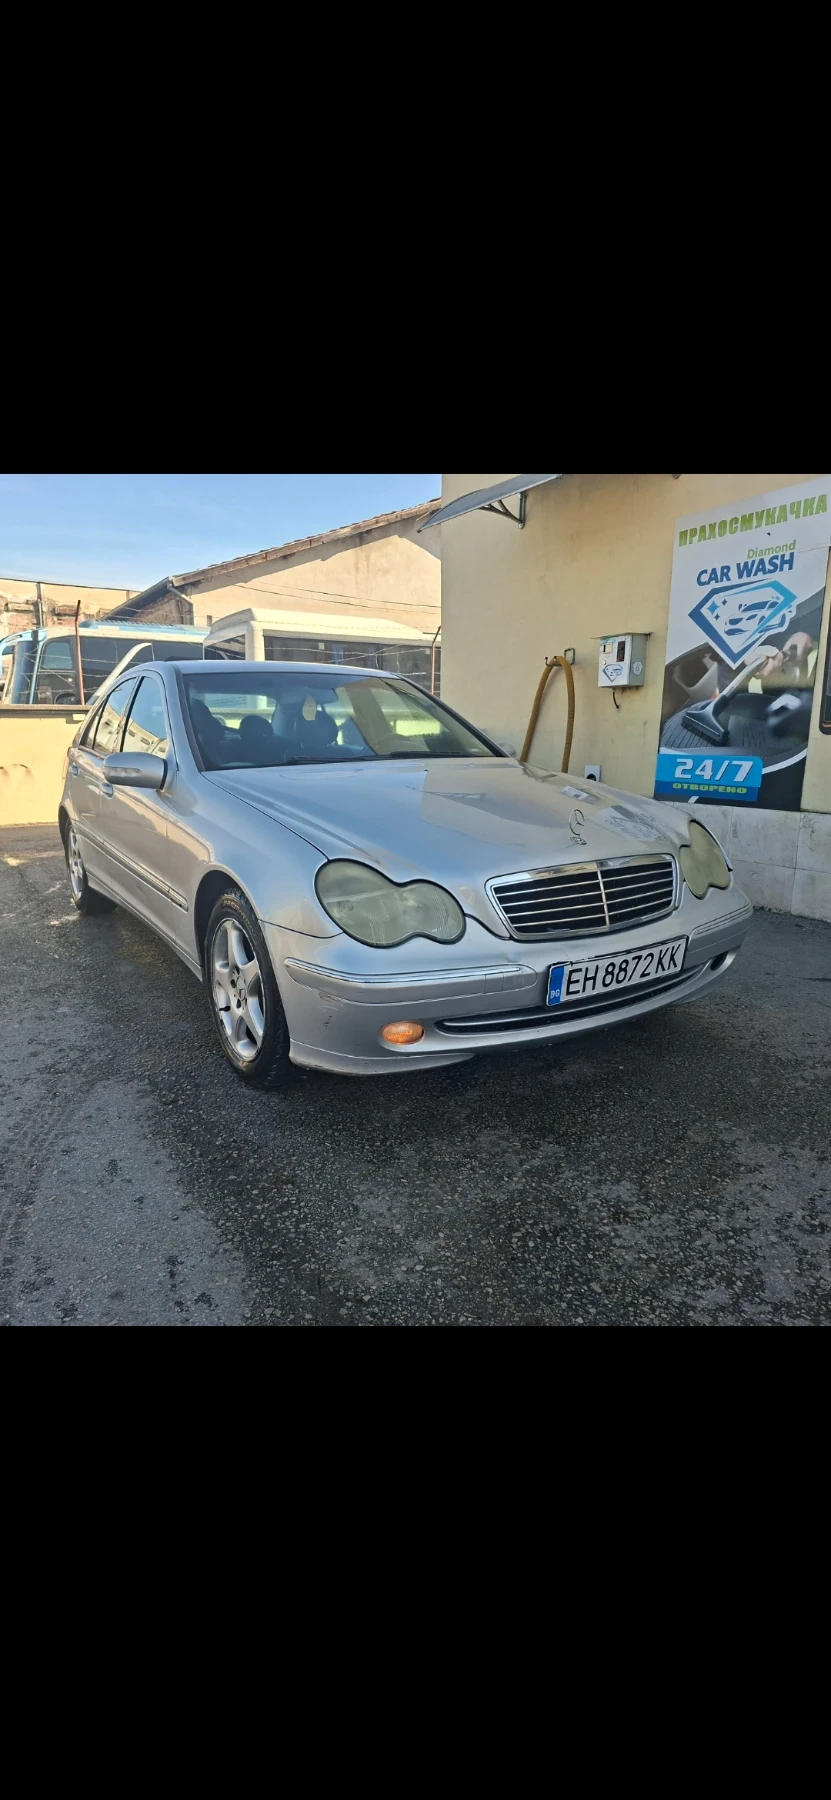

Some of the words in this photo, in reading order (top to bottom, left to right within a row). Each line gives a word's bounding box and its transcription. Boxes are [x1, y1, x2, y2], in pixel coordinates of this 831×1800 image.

[678, 494, 828, 547] ПРАХОСМУКАЧКА
[747, 539, 797, 559] Diamond
[696, 565, 731, 586] CAR
[736, 552, 795, 579] WASH
[674, 758, 754, 782] 24/7
[672, 782, 748, 794] ОТВОРЕНО
[550, 989, 561, 999] BG
